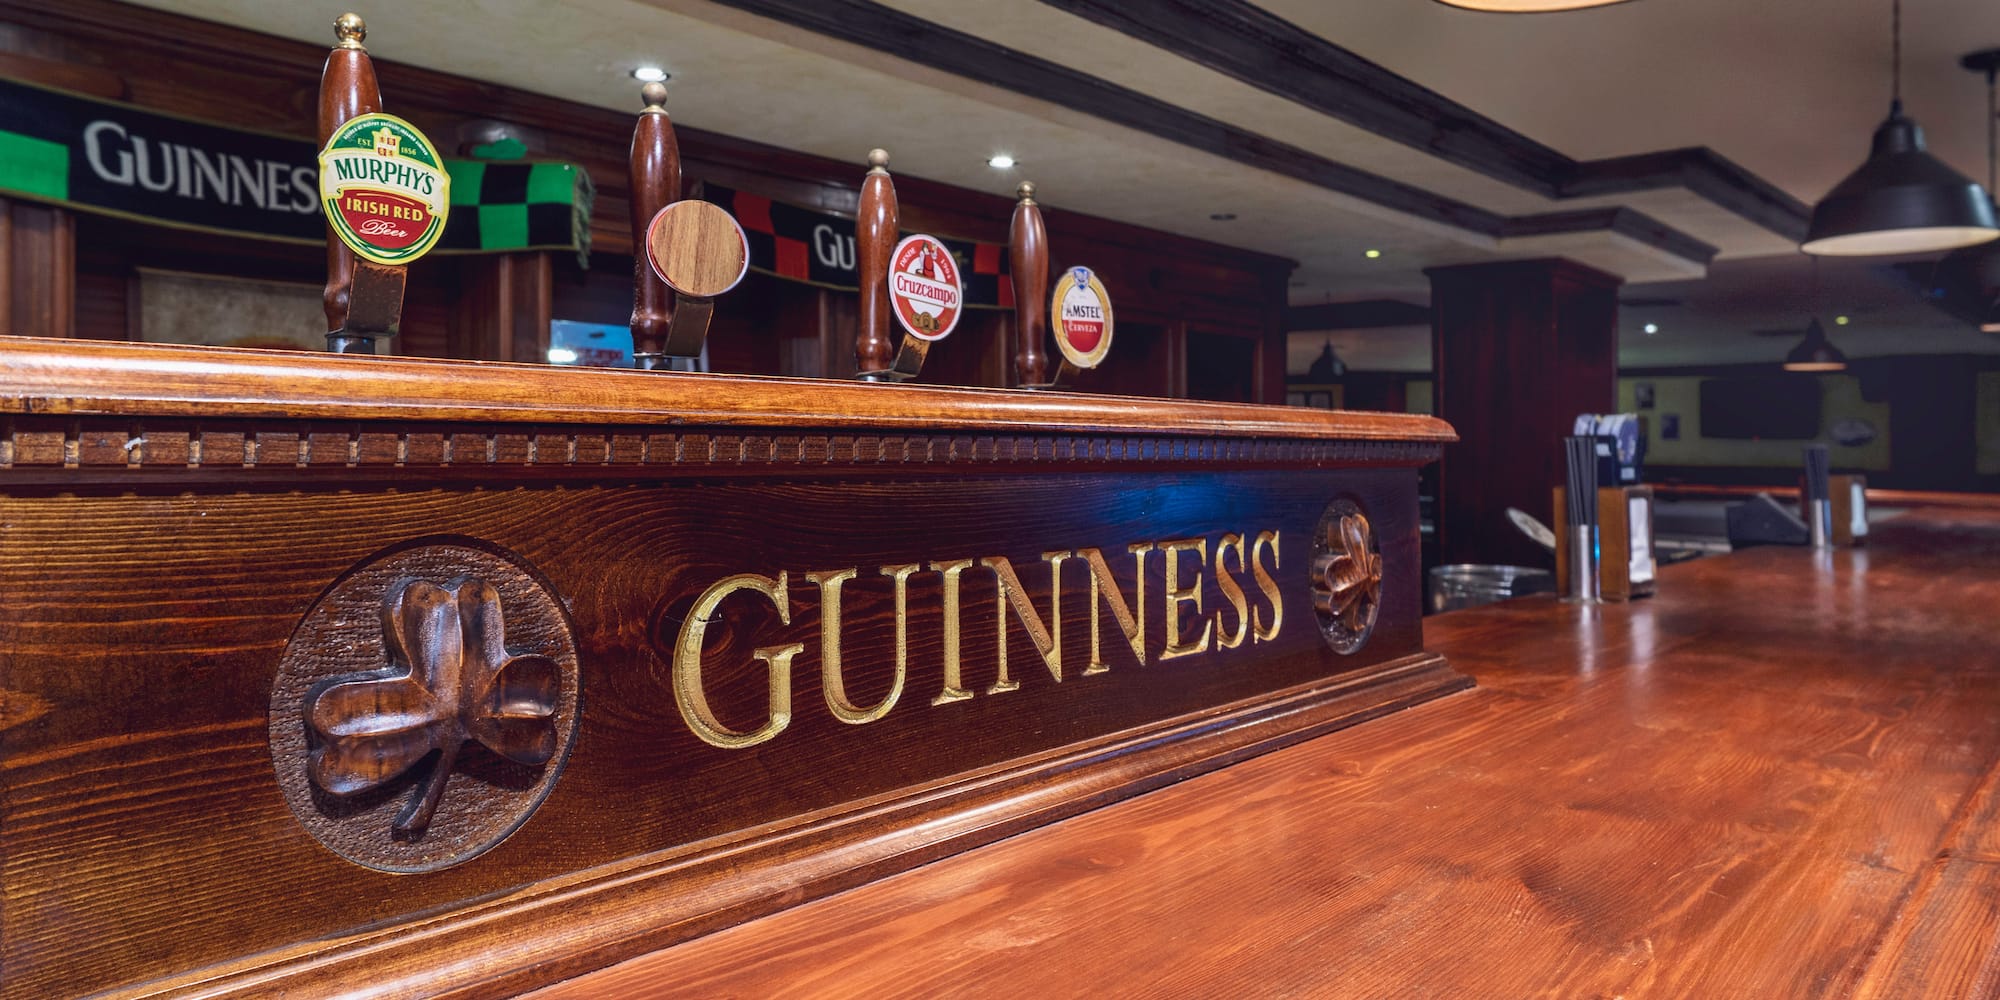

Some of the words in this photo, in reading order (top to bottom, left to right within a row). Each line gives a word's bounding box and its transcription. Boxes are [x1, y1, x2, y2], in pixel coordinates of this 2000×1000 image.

[84, 120, 323, 214] GUINNES
[334, 157, 435, 195] MURPHY'S
[346, 198, 389, 217] IRISH
[393, 205, 424, 222] RED
[359, 219, 409, 238] Beer
[897, 275, 957, 304] Cruzcampo
[1066, 304, 1100, 318] AMSTEL
[672, 529, 1284, 749] GUINNESS
